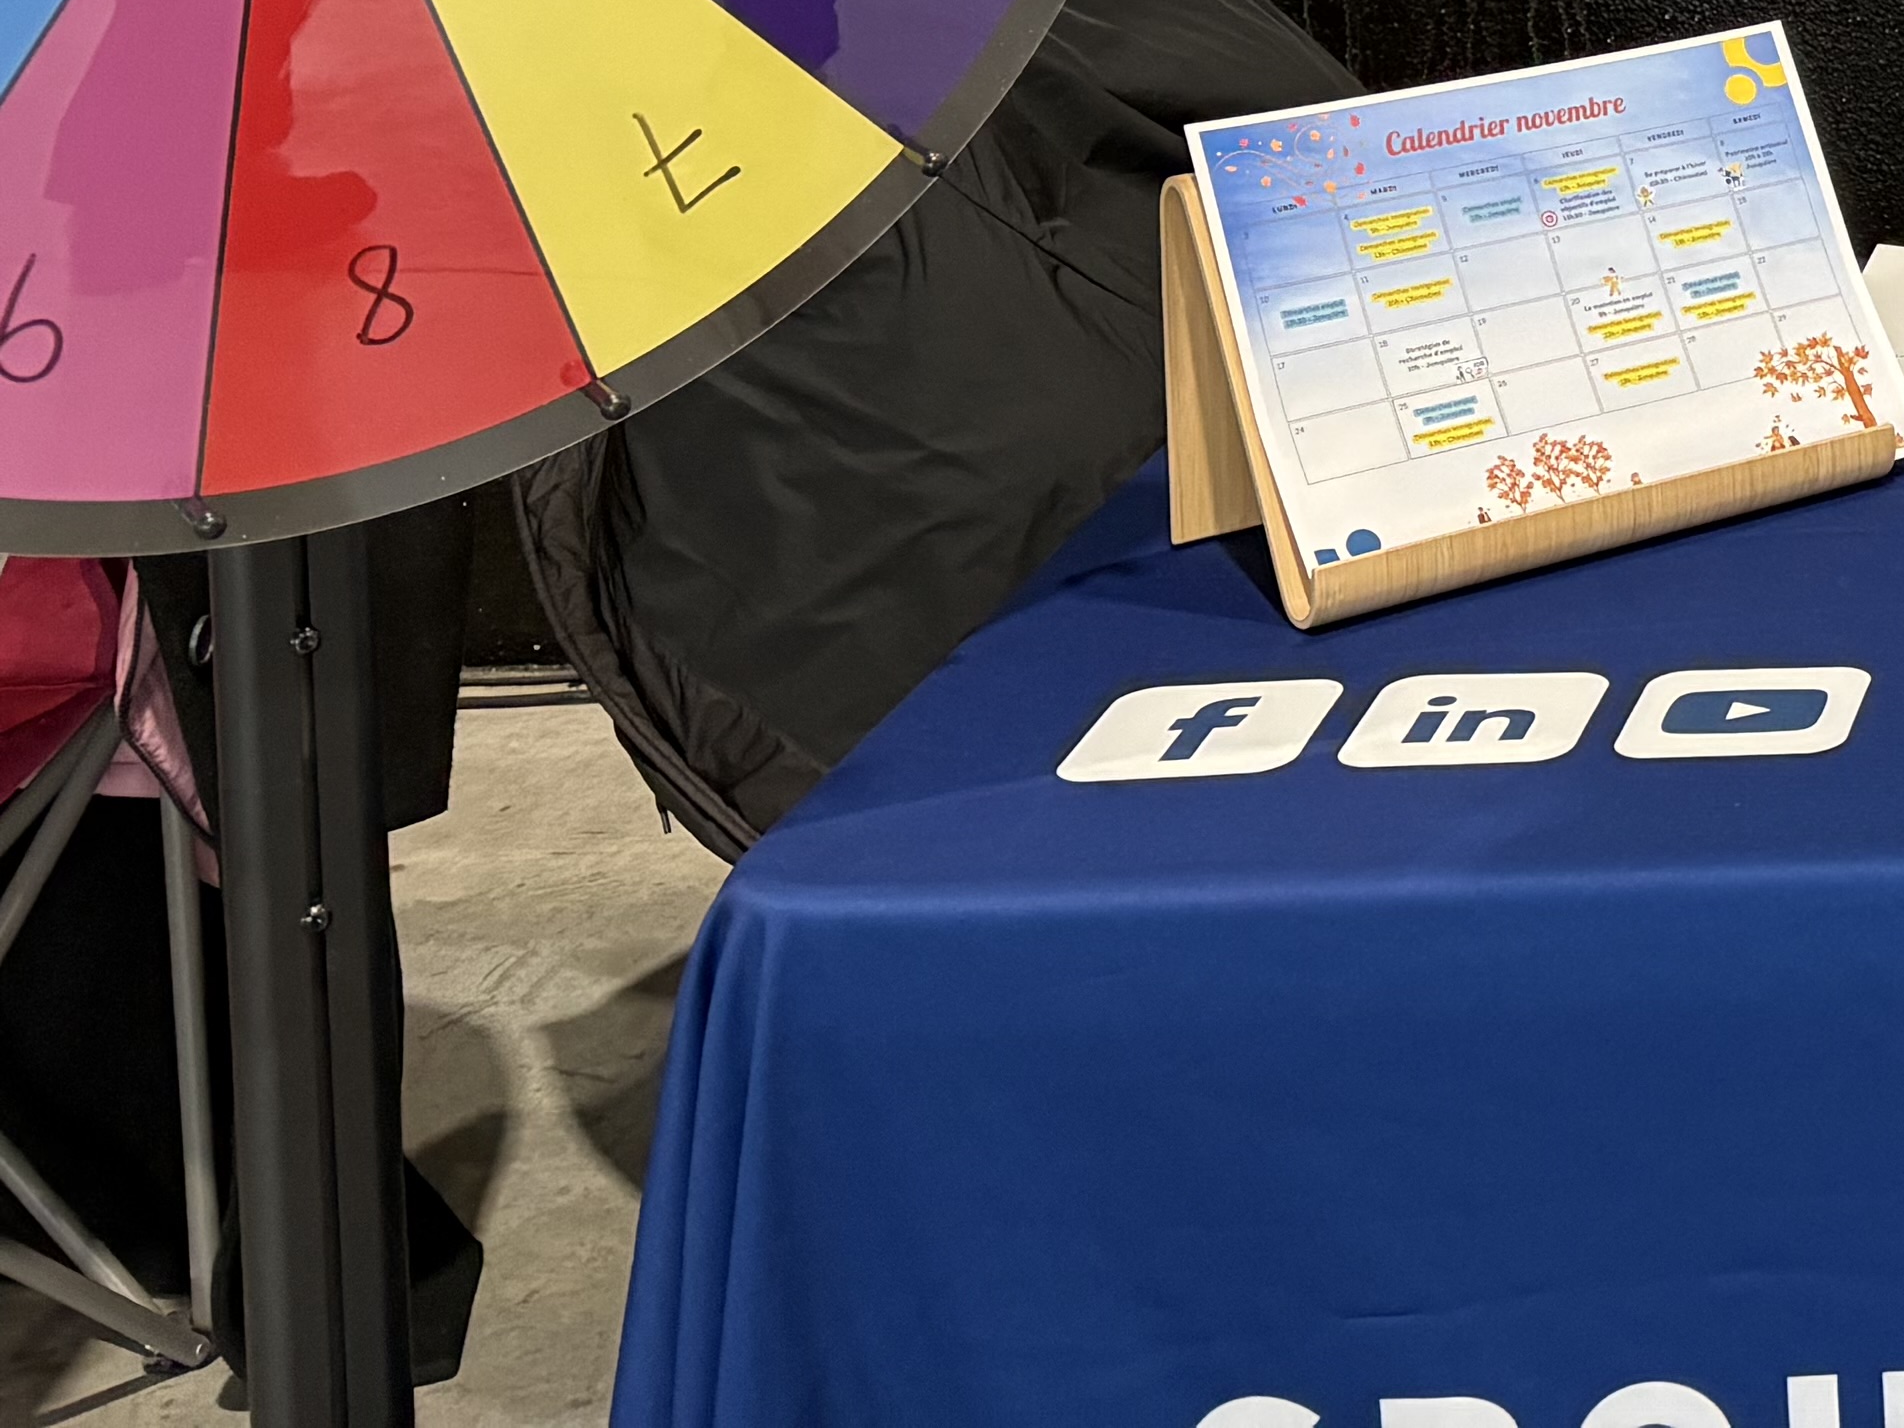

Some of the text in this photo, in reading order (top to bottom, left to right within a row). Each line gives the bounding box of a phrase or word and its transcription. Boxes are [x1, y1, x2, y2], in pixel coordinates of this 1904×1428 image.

[1385, 95, 1627, 156] Calendrier novembre
[1647, 129, 1685, 142] VENDREDI
[632, 112, 741, 213] 7
[1458, 165, 1499, 179] MERCREDI
[1370, 185, 1398, 196] MARDI
[347, 244, 414, 346] 8
